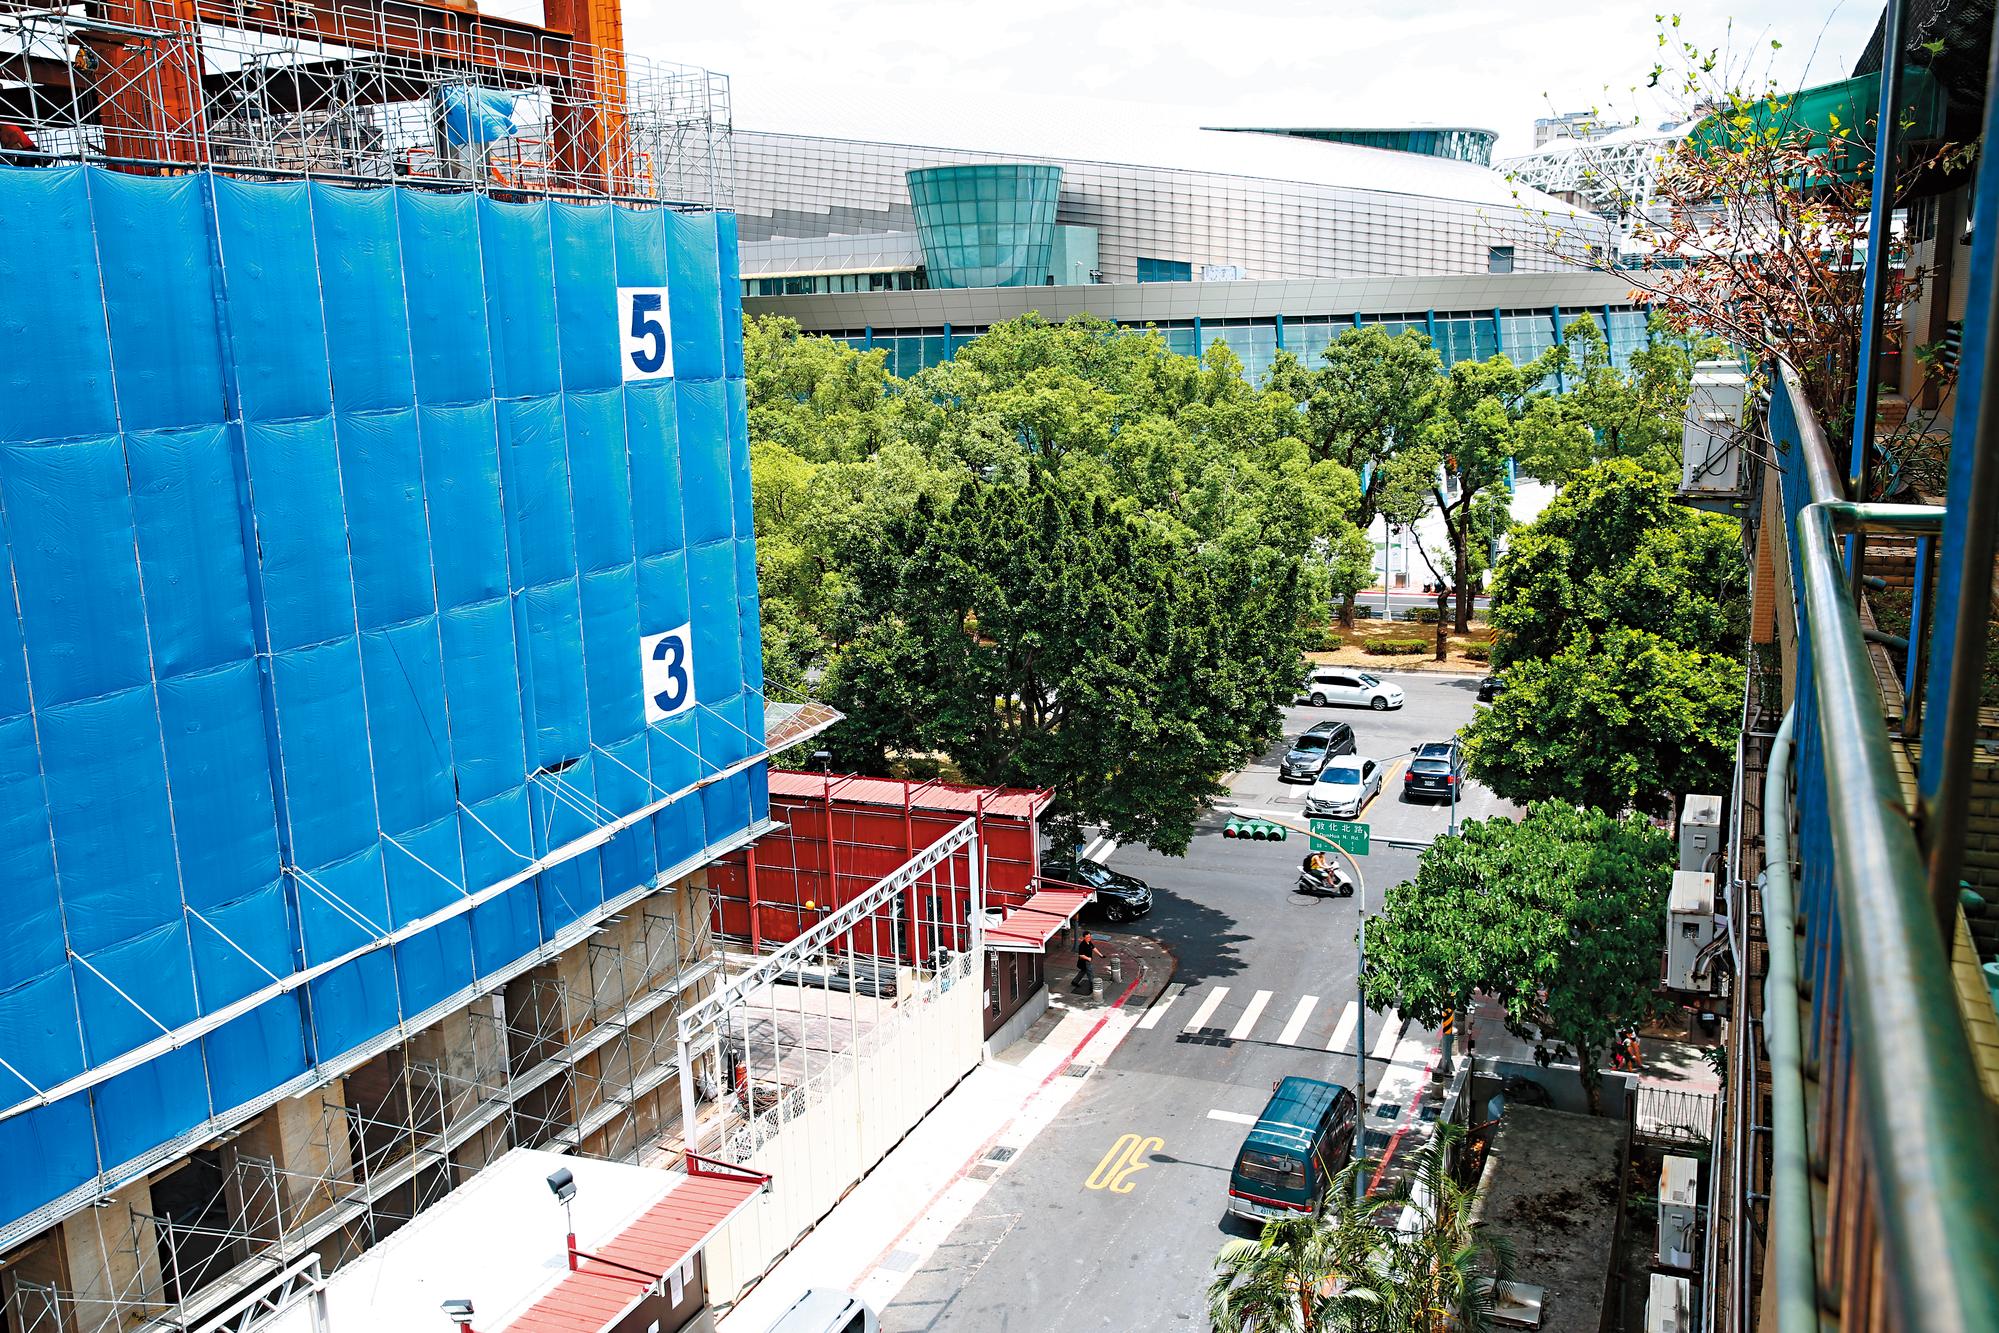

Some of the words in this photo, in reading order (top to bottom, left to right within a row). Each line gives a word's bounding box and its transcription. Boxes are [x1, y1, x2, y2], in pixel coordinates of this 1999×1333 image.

[631, 294, 666, 373] 5
[653, 635, 688, 711] 3
[1316, 821, 1363, 833] 敦化北路
[1084, 1133, 1165, 1194] 30
